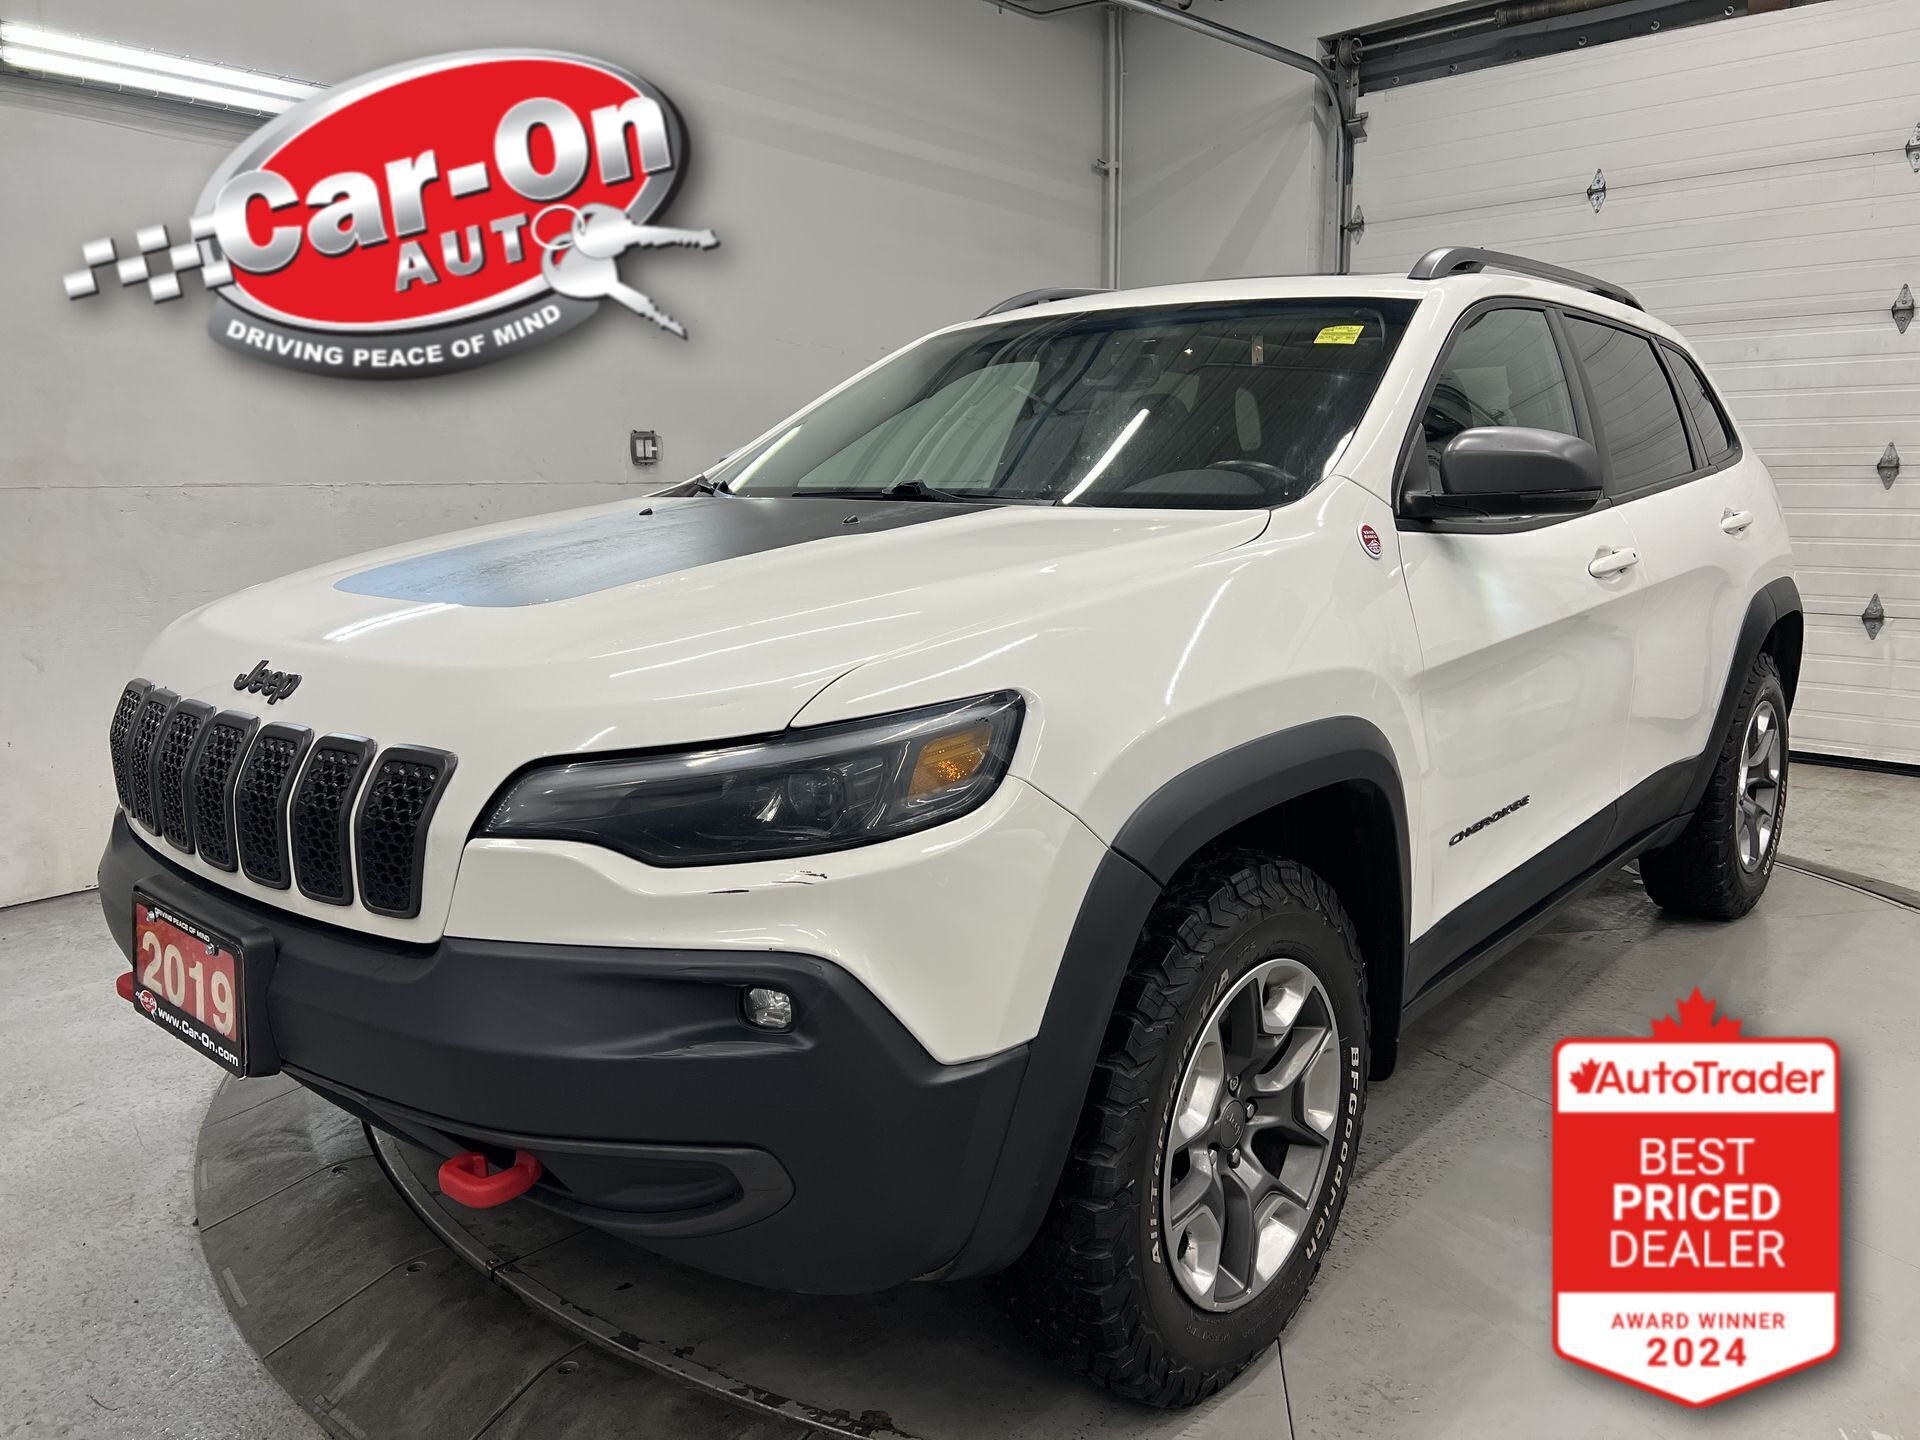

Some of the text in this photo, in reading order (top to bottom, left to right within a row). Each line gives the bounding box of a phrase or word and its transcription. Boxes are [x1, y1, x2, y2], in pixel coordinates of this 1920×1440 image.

[234, 660, 302, 705] Jeep
[1449, 795, 1530, 846] CHEROKEE
[143, 930, 234, 1035] 2019
[157, 1006, 239, 1067] www.Car-On.com
